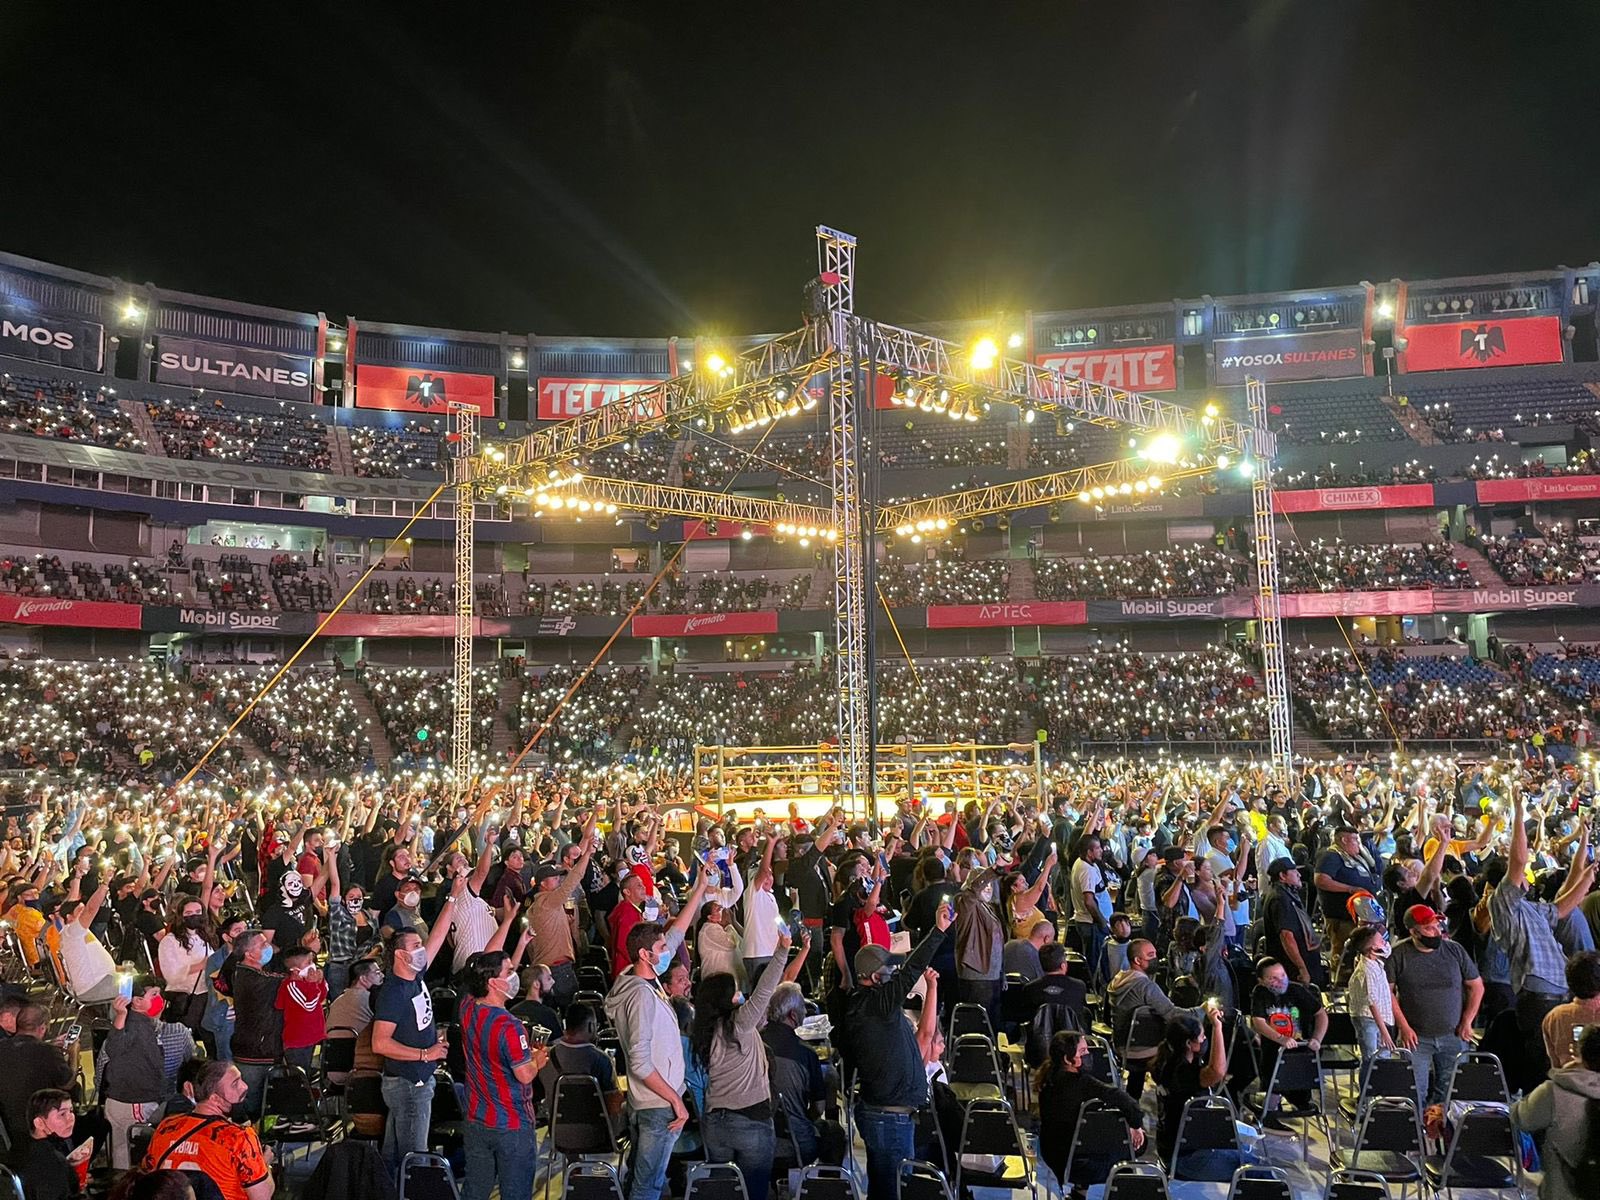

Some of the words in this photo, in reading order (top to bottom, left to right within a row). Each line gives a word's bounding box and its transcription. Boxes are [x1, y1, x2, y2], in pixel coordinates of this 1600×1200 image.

[0, 320, 74, 350] MOS
[160, 352, 309, 388] SULTANES
[1325, 491, 1374, 503] CHIMEX
[1473, 590, 1520, 604] Mobil
[1523, 589, 1576, 604] Super
[14, 600, 73, 619] Kermato
[1121, 600, 1164, 615] Mobil
[1167, 600, 1214, 615] Super
[180, 609, 225, 625] Mobil
[229, 611, 279, 628] Super
[683, 613, 726, 633] Kermato
